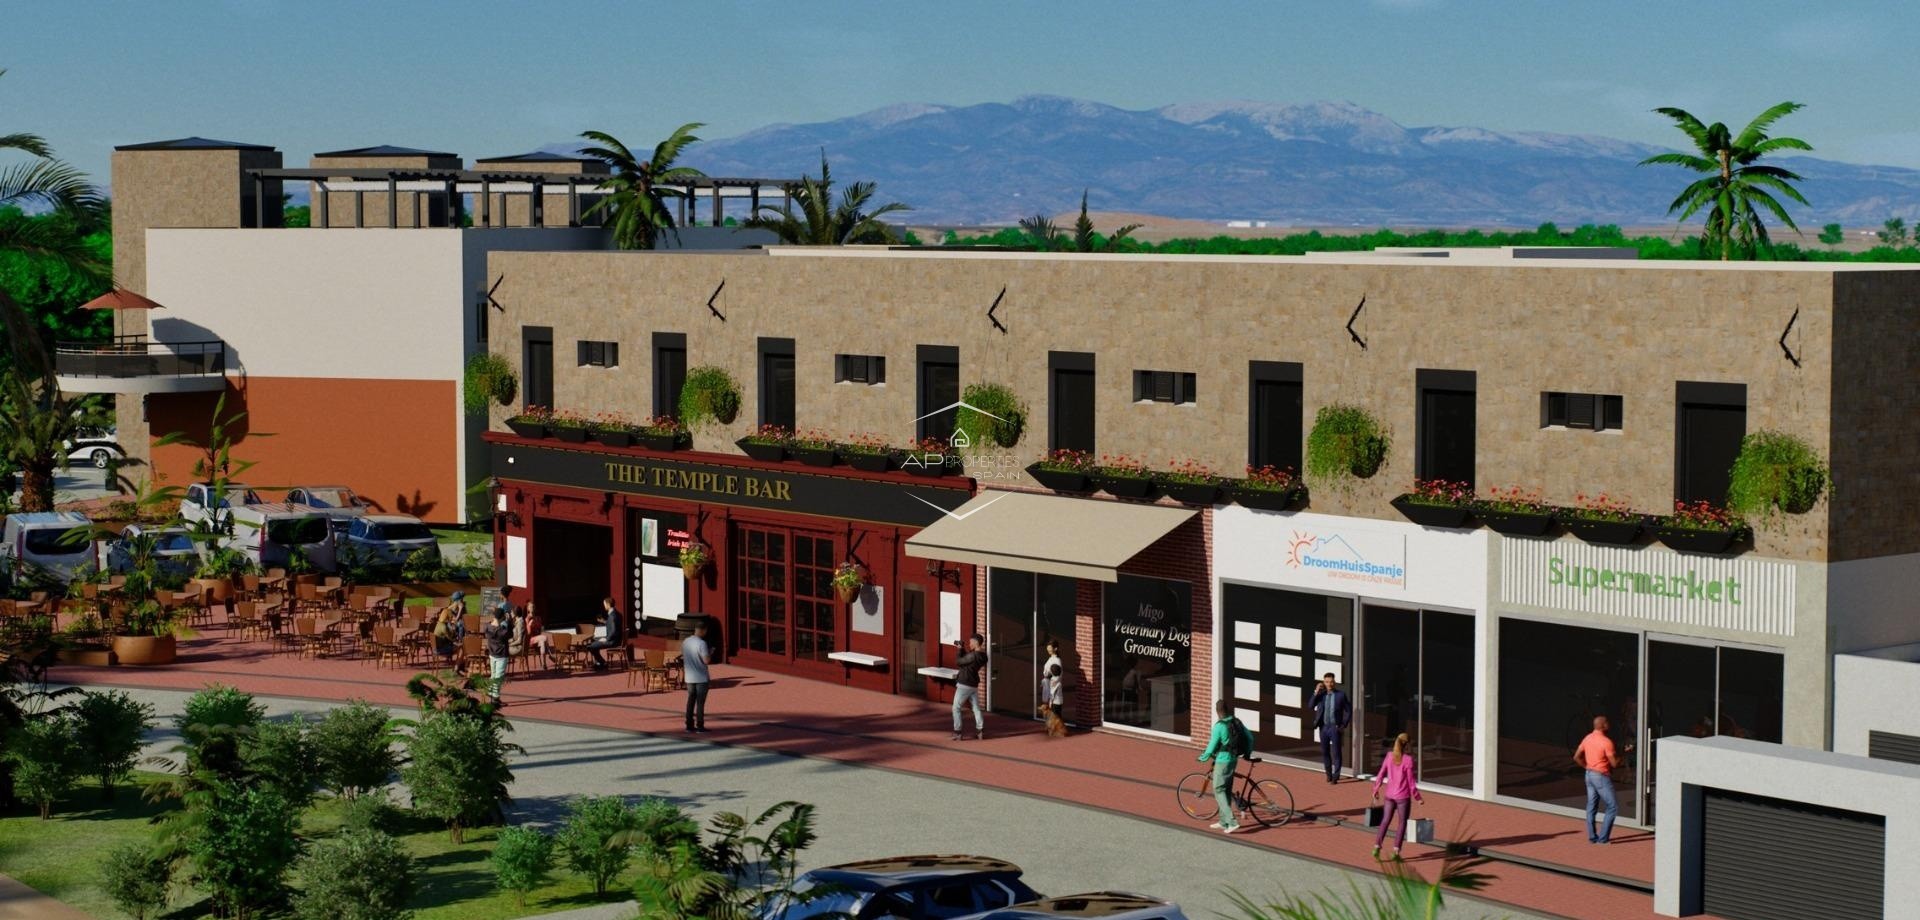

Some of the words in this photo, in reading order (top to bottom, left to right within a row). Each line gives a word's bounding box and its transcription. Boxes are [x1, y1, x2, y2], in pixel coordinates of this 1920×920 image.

[605, 463, 647, 484] THE
[652, 467, 739, 495] TEMPLE
[745, 477, 792, 500] BAR
[1303, 555, 1403, 578] DroomHuisSpanje
[1549, 557, 1742, 605] Supermarket
[1138, 602, 1164, 623] Migo
[1114, 619, 1166, 643] Veterinary
[1168, 626, 1190, 647] Dog
[1124, 638, 1176, 663] Grooming
